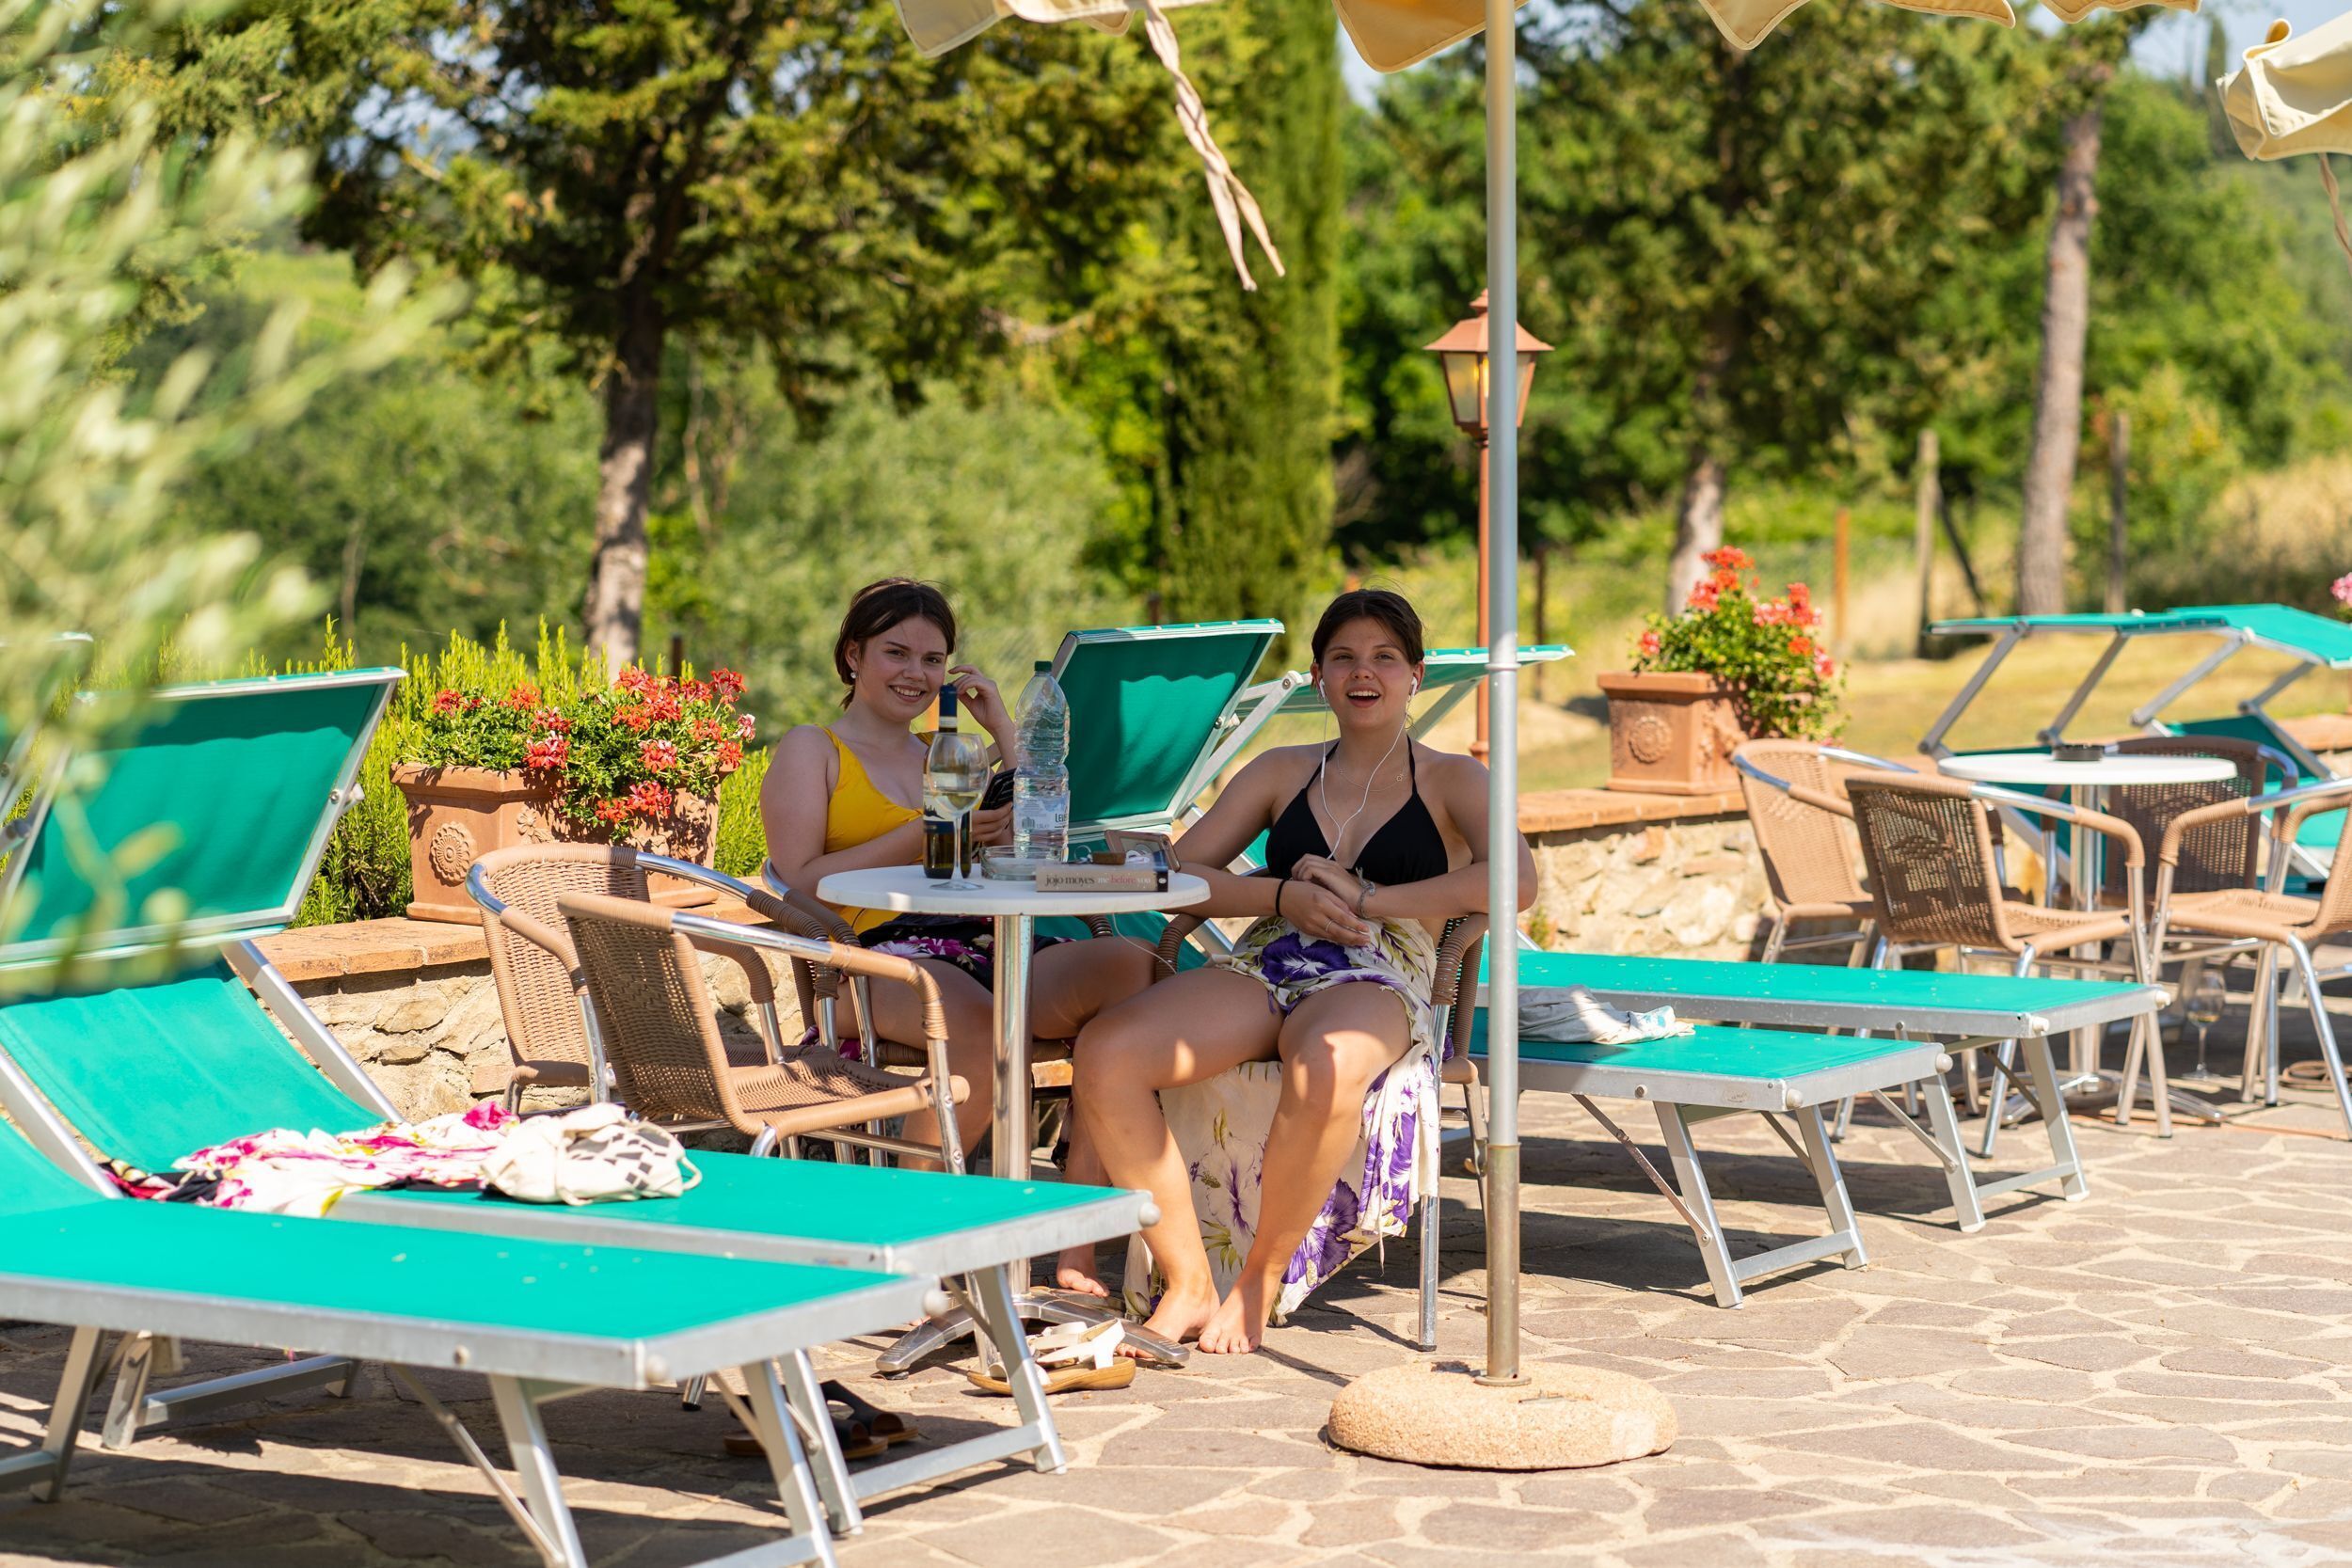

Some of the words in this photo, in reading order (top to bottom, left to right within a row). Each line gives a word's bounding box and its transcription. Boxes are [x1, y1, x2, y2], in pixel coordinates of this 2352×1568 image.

[1045, 875, 1063, 887] jojo
[1065, 877, 1095, 887] moyes
[1110, 875, 1136, 884] before
[1136, 877, 1151, 886] you
